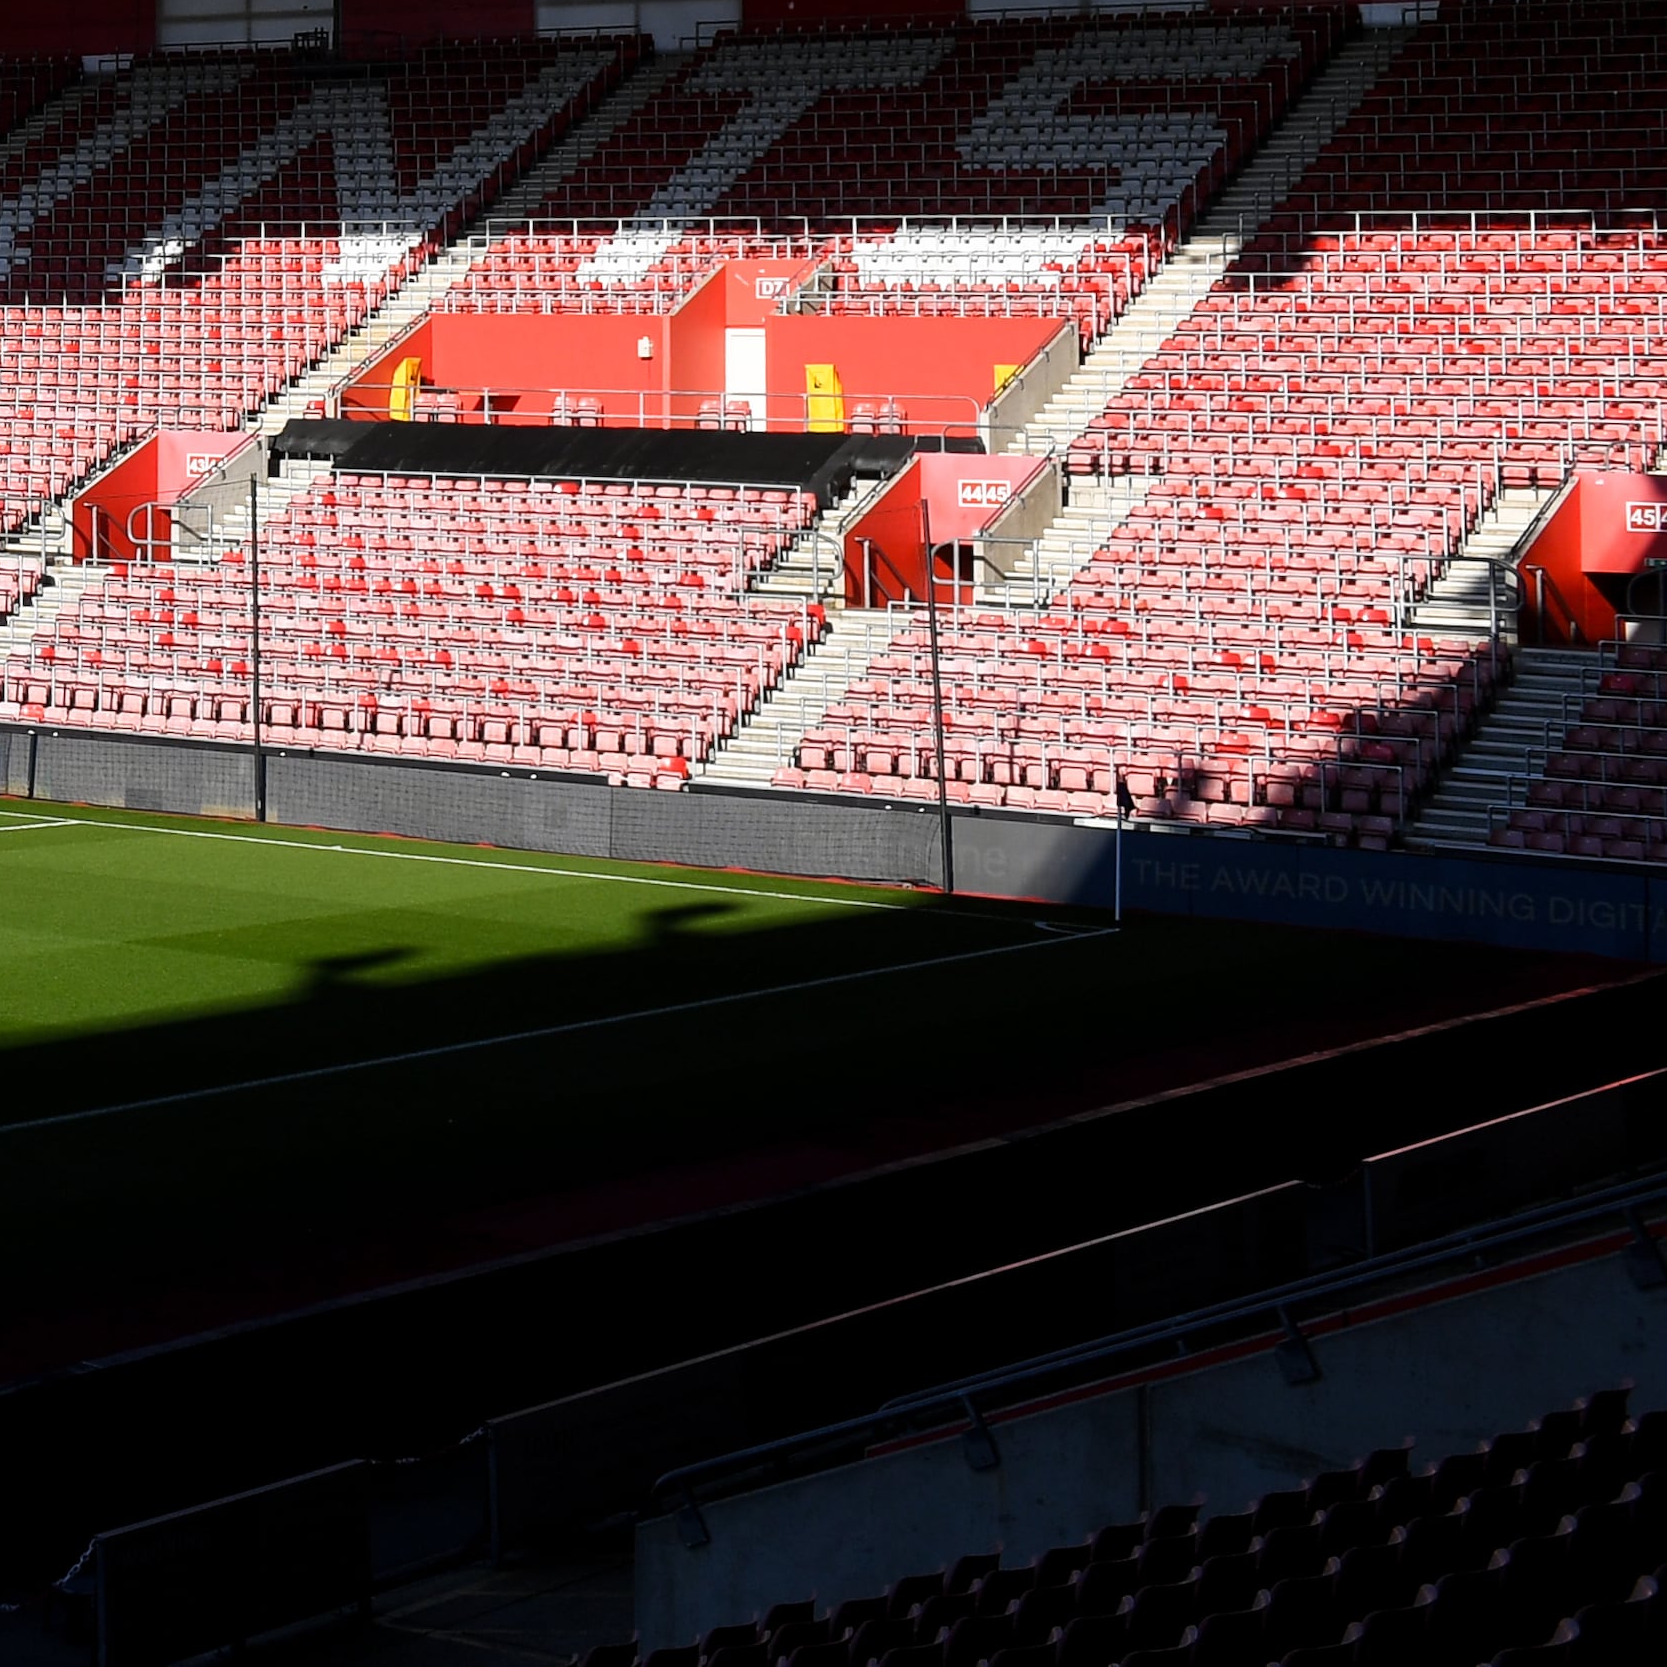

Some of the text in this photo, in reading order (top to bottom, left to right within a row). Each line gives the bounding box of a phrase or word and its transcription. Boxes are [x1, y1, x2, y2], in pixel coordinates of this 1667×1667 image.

[761, 281, 784, 296] D7
[962, 485, 1007, 502] 44 45
[1630, 508, 1656, 526] 45
[1130, 857, 1201, 892] THE
[1210, 866, 1349, 904] AWARD
[1360, 877, 1536, 922] WINNING
